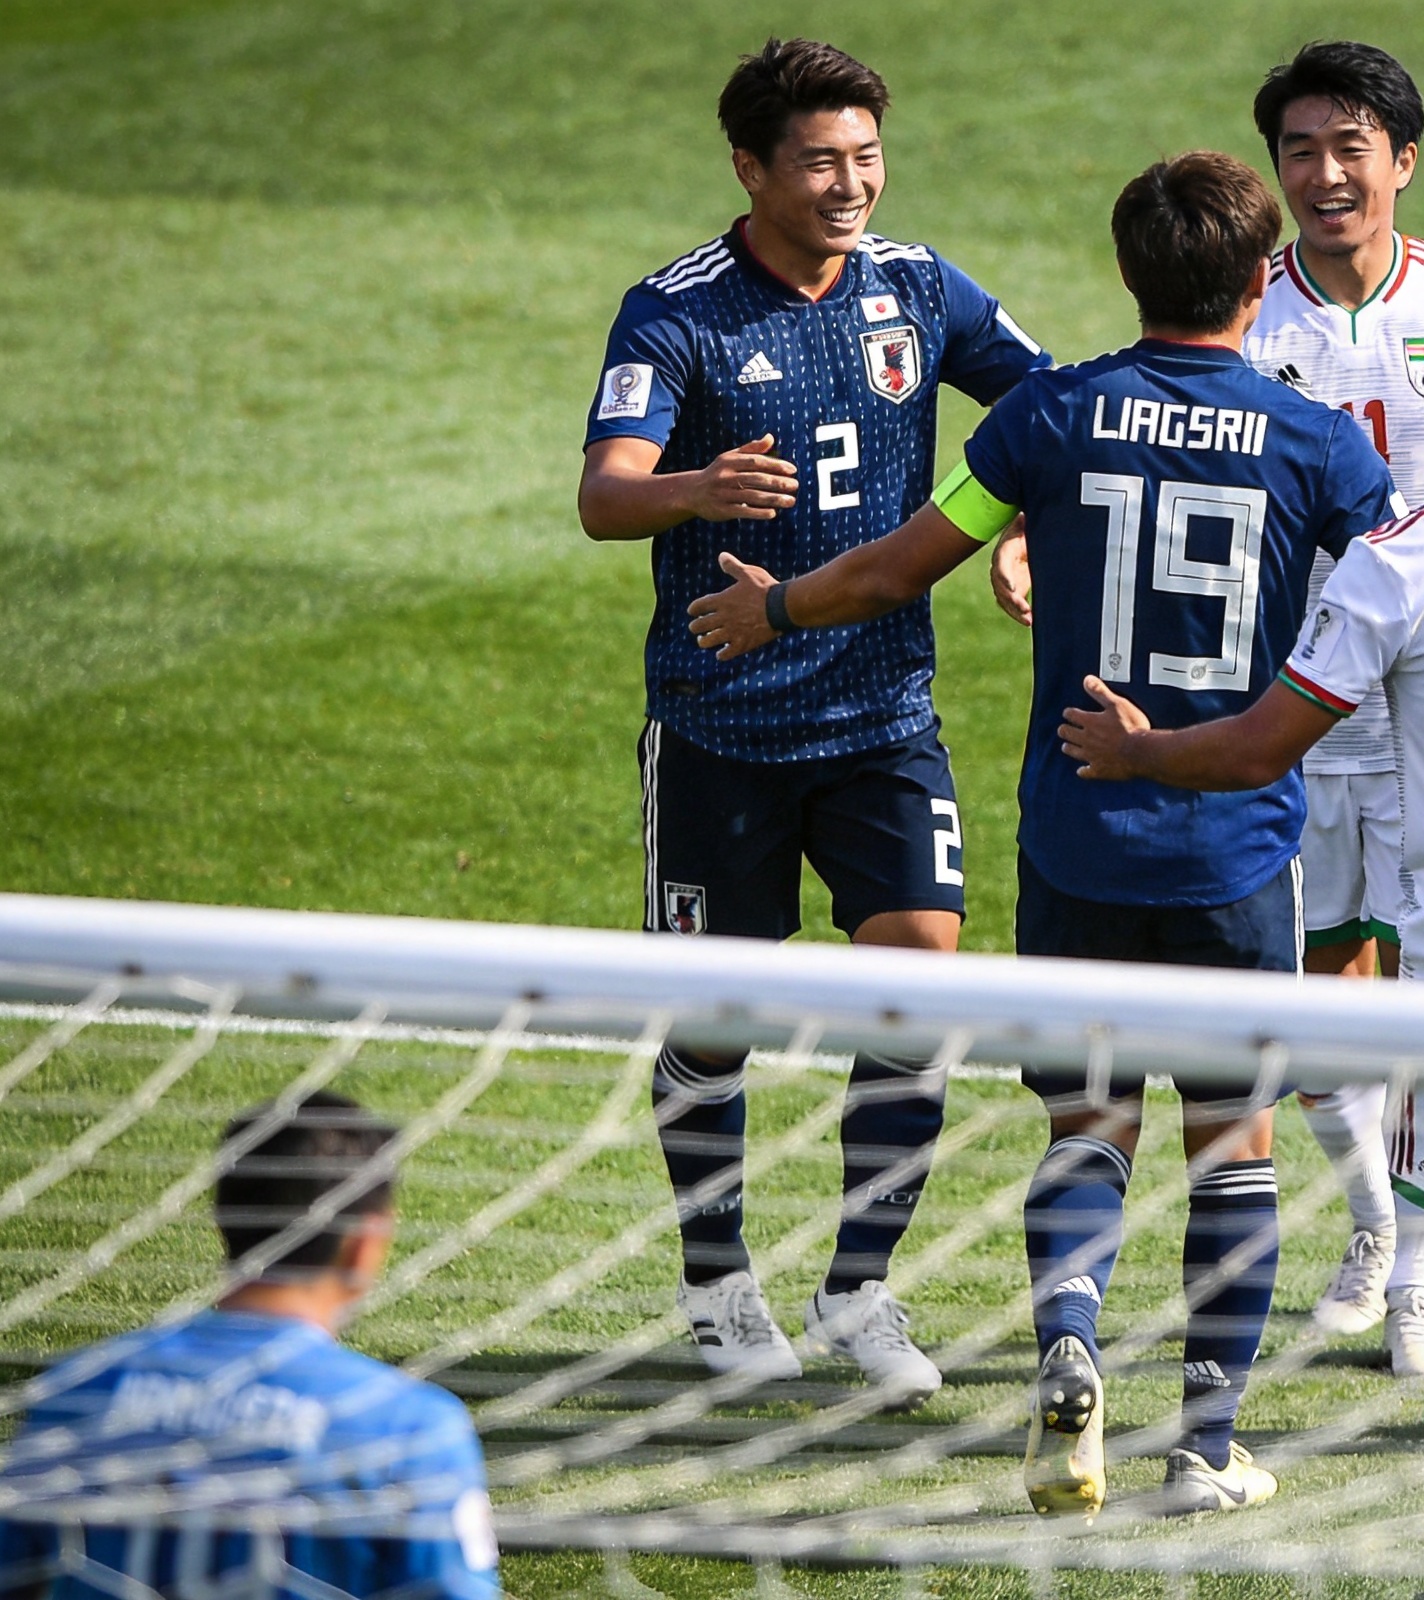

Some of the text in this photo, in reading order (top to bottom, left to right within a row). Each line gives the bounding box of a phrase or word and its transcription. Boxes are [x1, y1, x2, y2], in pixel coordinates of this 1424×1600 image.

[815, 422, 861, 511] 2
[1080, 472, 1268, 692] 19
[929, 797, 965, 887] 2
